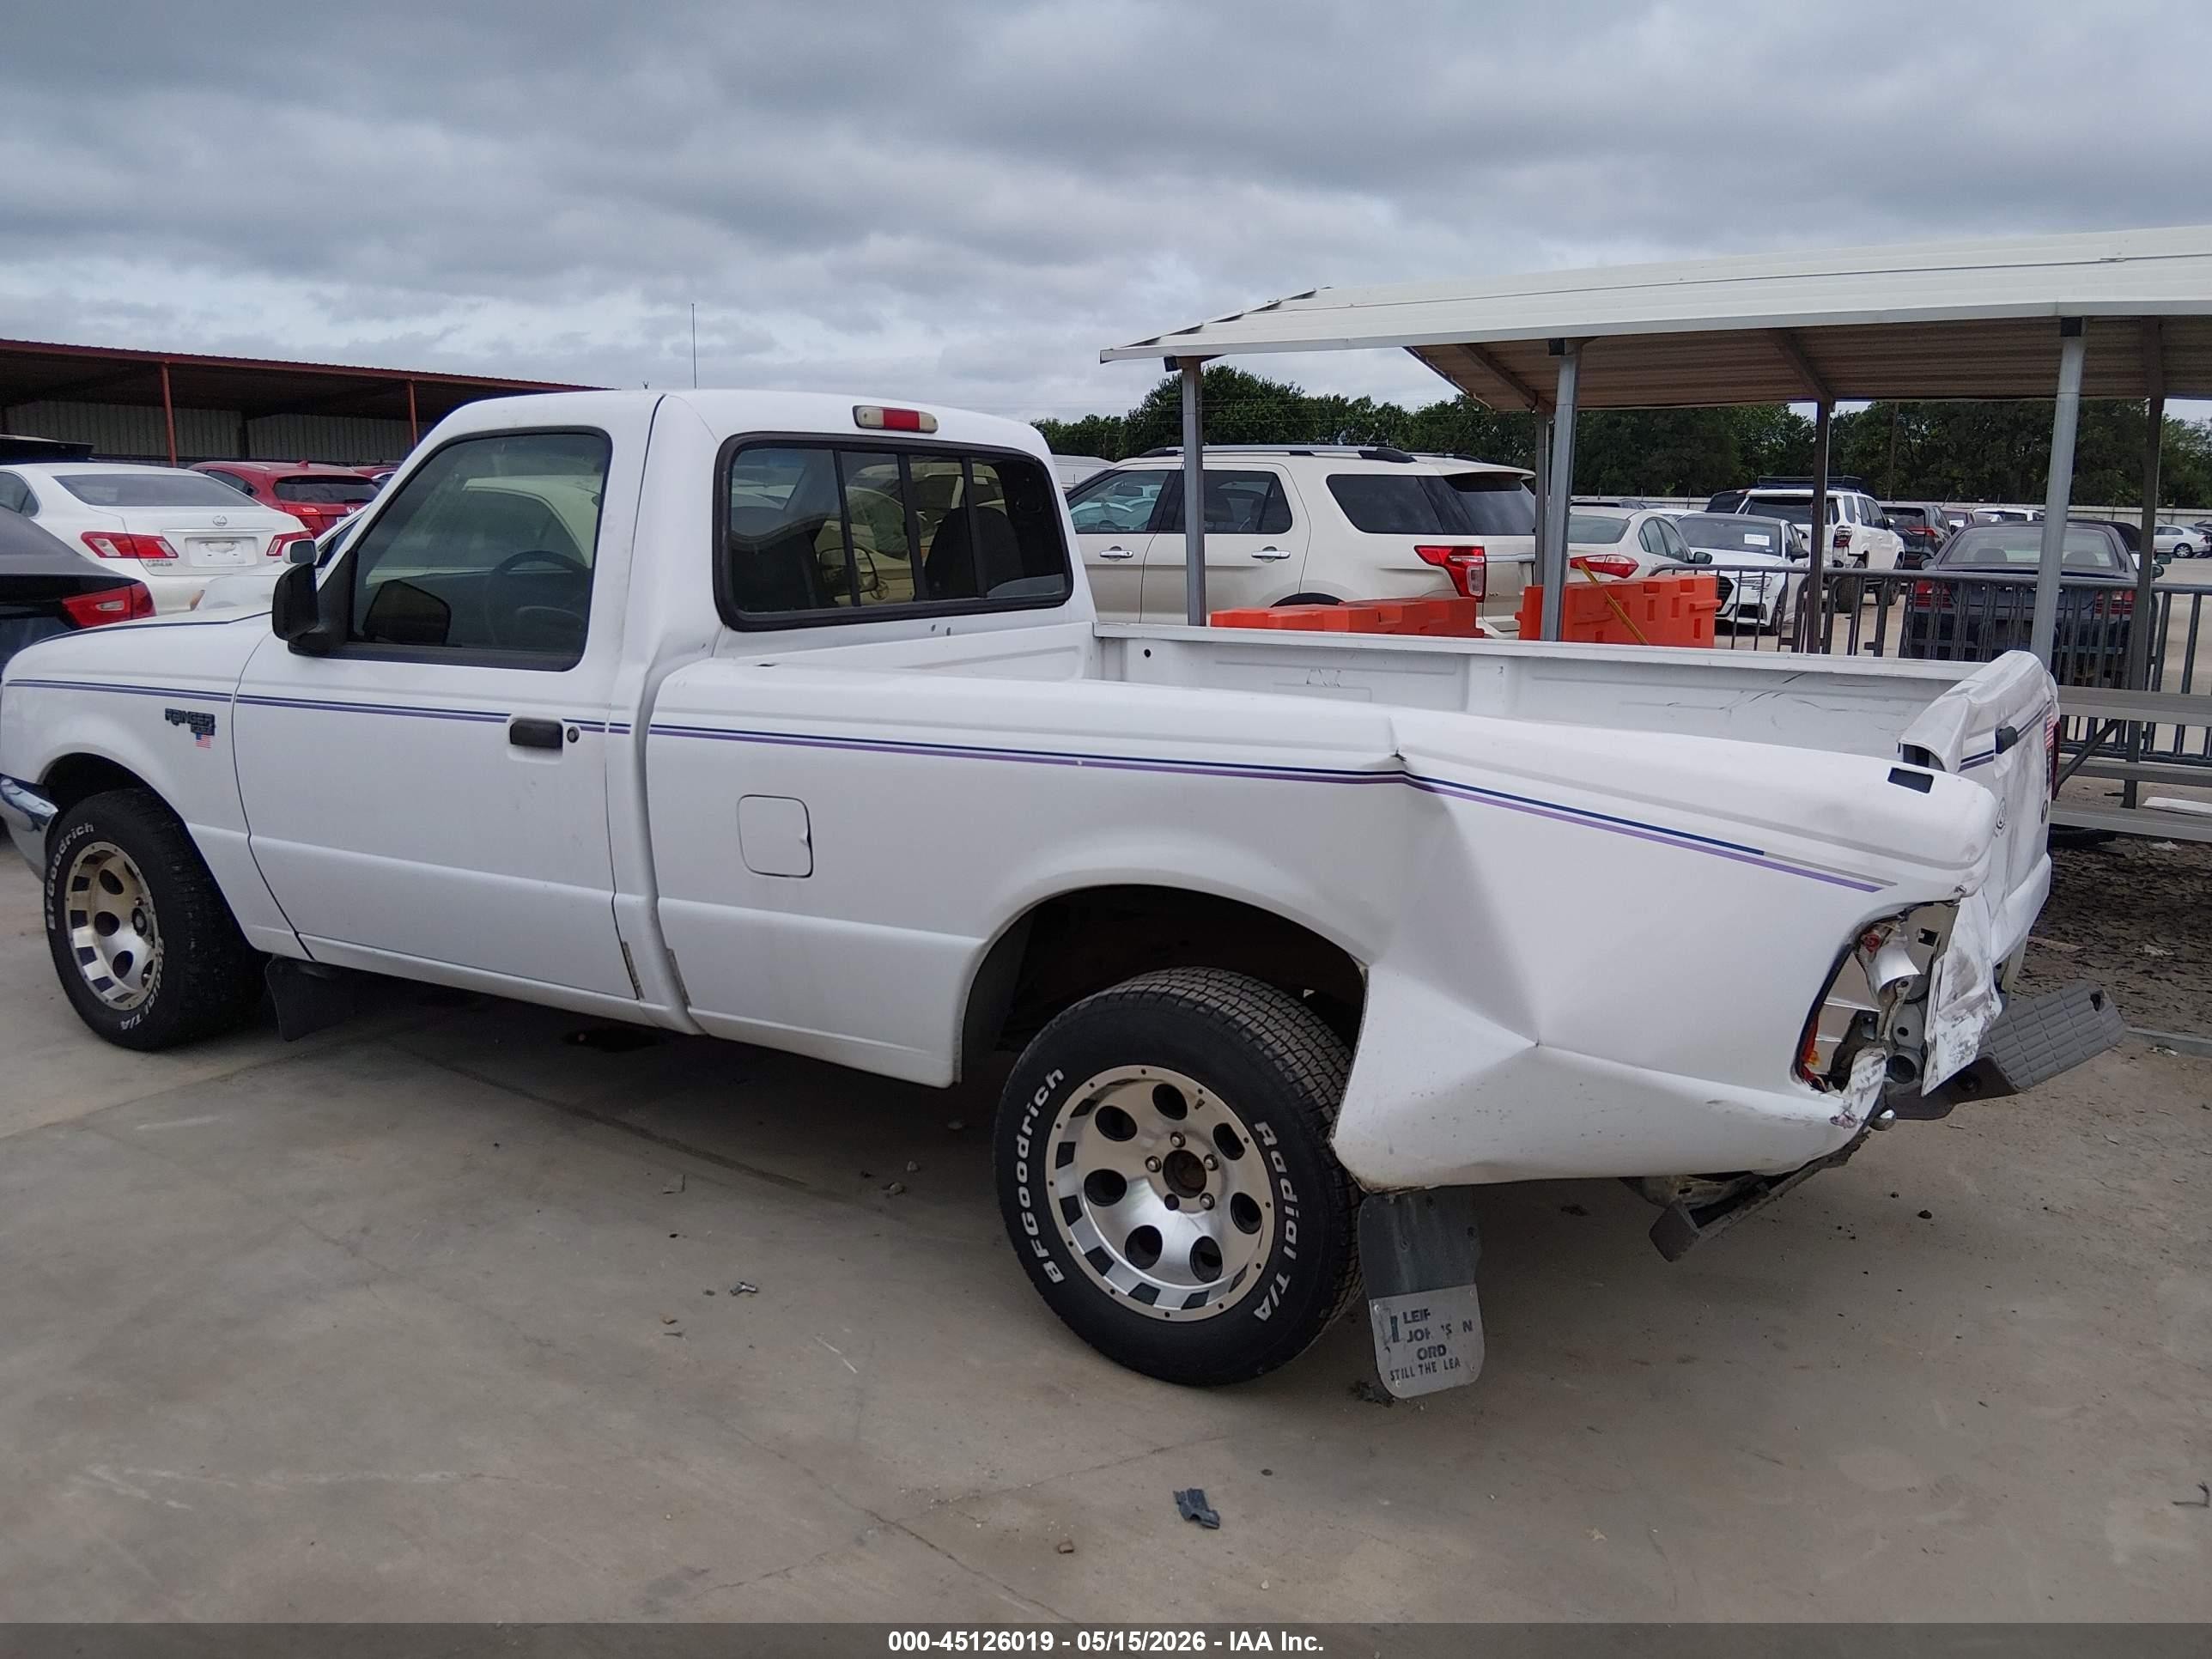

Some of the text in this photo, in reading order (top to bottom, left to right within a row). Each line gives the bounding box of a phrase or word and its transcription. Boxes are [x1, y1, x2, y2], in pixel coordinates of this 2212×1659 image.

[120, 1012, 143, 1030] T/A
[1014, 1068, 1066, 1284] BFGoodrich
[1253, 1121, 1301, 1322] Radial T/A
[1402, 1308, 1431, 1324] LEIF
[1389, 1367, 1415, 1381] STILL
[1418, 1362, 1437, 1375] THE
